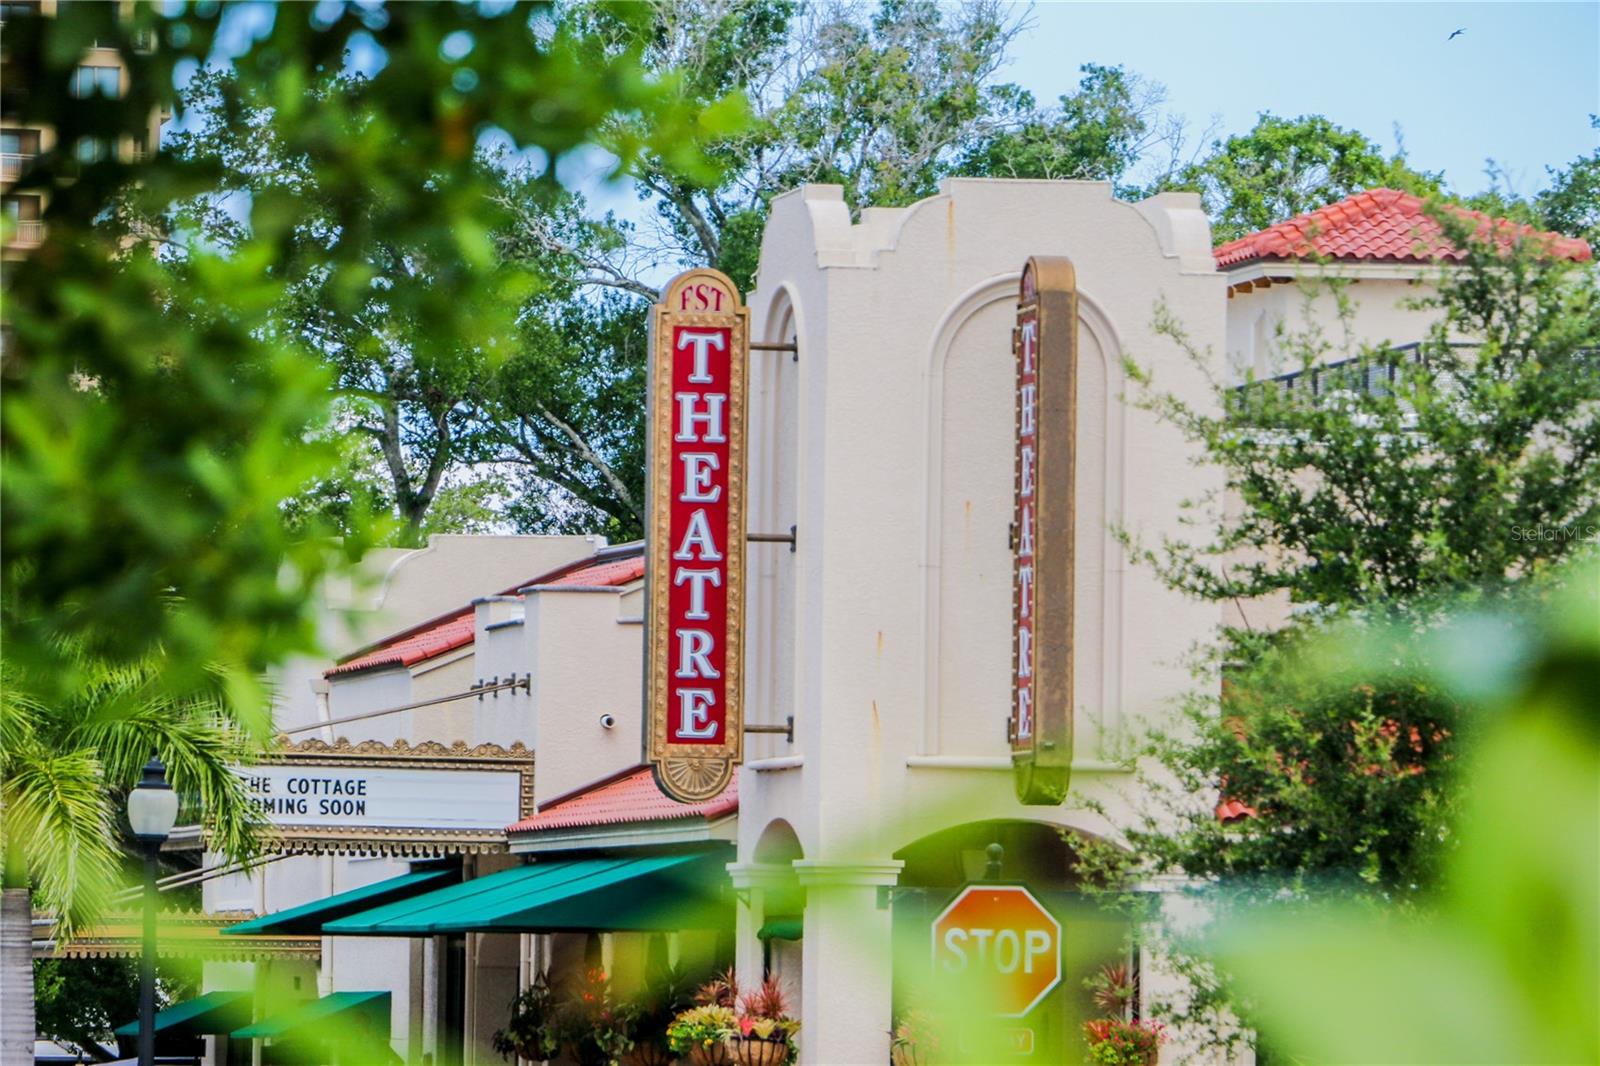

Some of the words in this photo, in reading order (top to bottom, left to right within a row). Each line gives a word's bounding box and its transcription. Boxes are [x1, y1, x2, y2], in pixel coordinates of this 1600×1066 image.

[680, 284, 725, 313] FST
[674, 329, 727, 738] THEATRE
[1018, 321, 1036, 738] THEATRE
[287, 778, 366, 796] COTTAGE
[241, 798, 308, 815] OMING
[319, 799, 366, 816] SOON
[944, 927, 1051, 974] STOP
